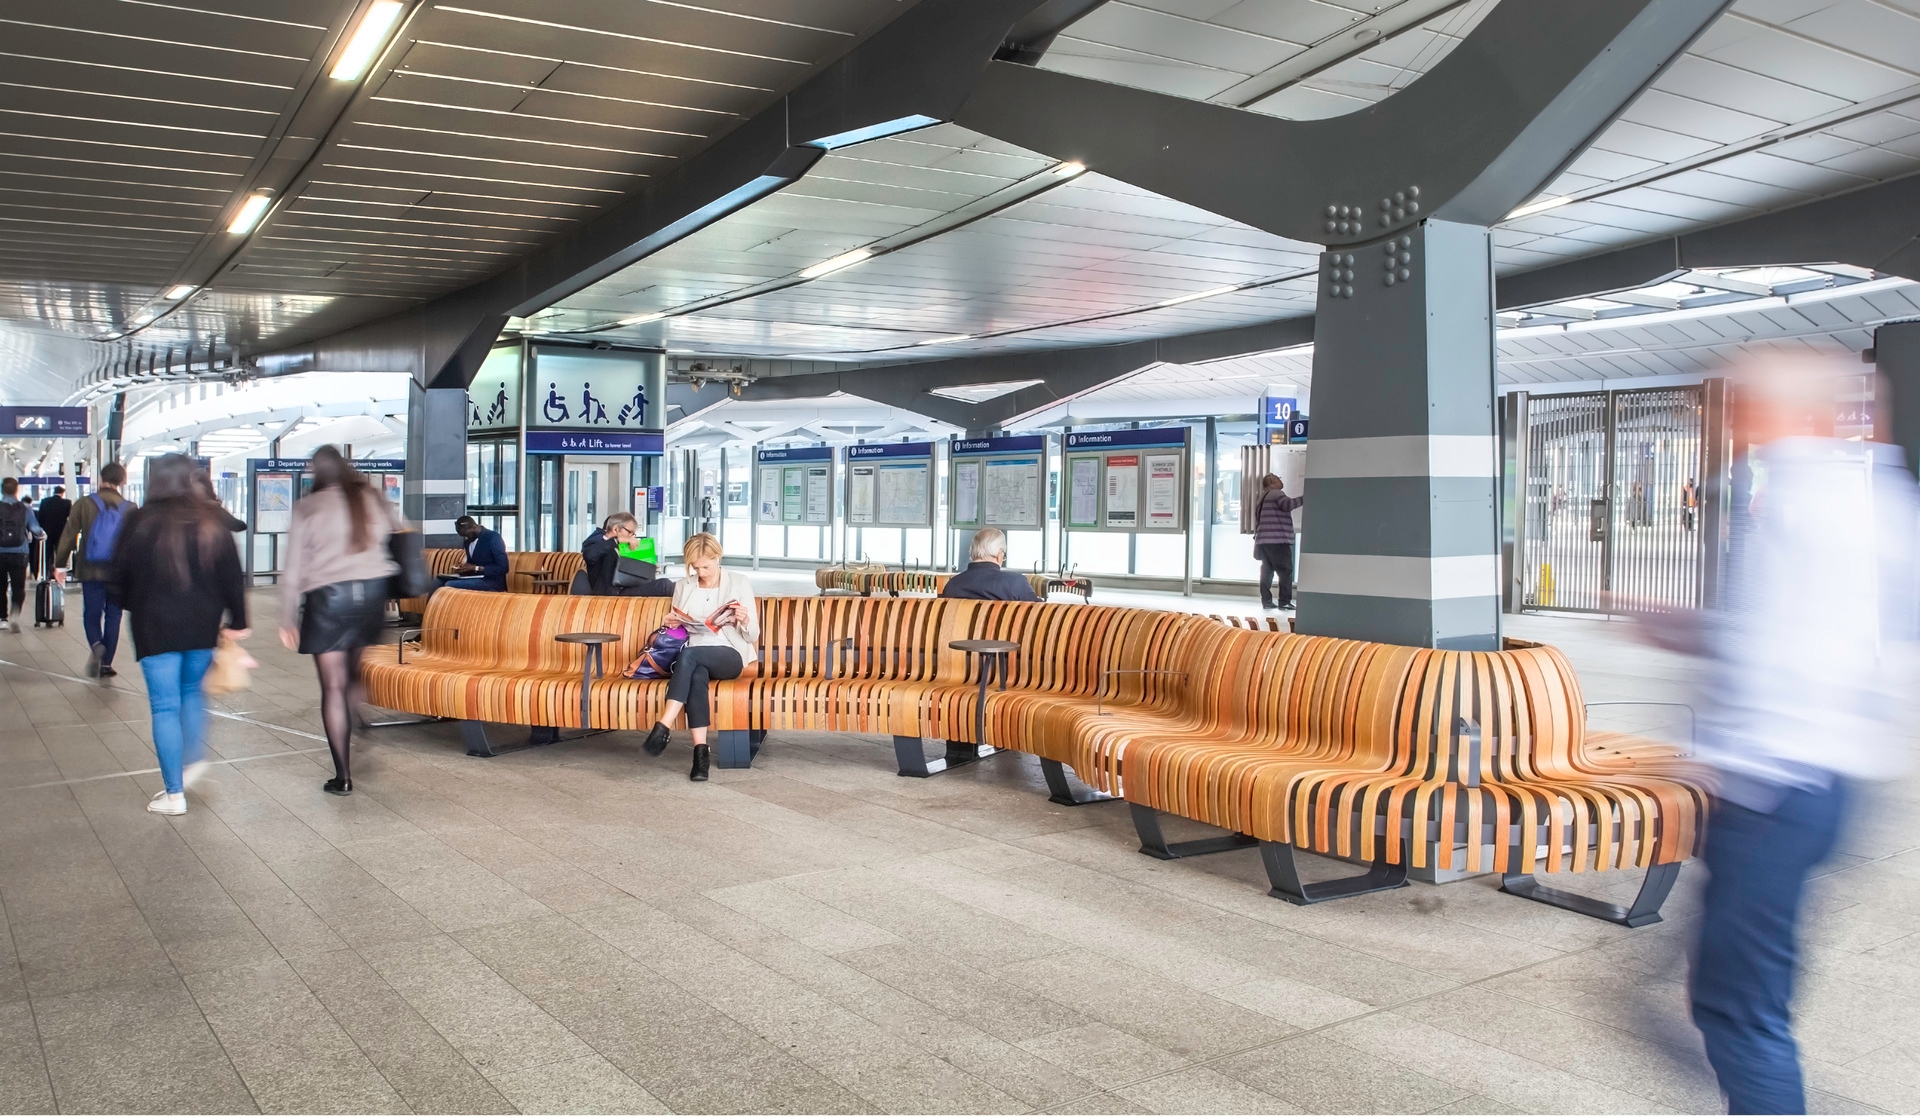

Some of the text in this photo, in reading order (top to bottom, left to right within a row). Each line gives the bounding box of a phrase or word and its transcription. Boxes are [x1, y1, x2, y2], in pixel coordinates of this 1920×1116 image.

[1274, 402, 1291, 420] 10
[1078, 434, 1112, 443] Information
[589, 439, 603, 448] Lift
[962, 441, 990, 449] Information
[858, 447, 884, 455] Information
[278, 460, 305, 468] Departure
